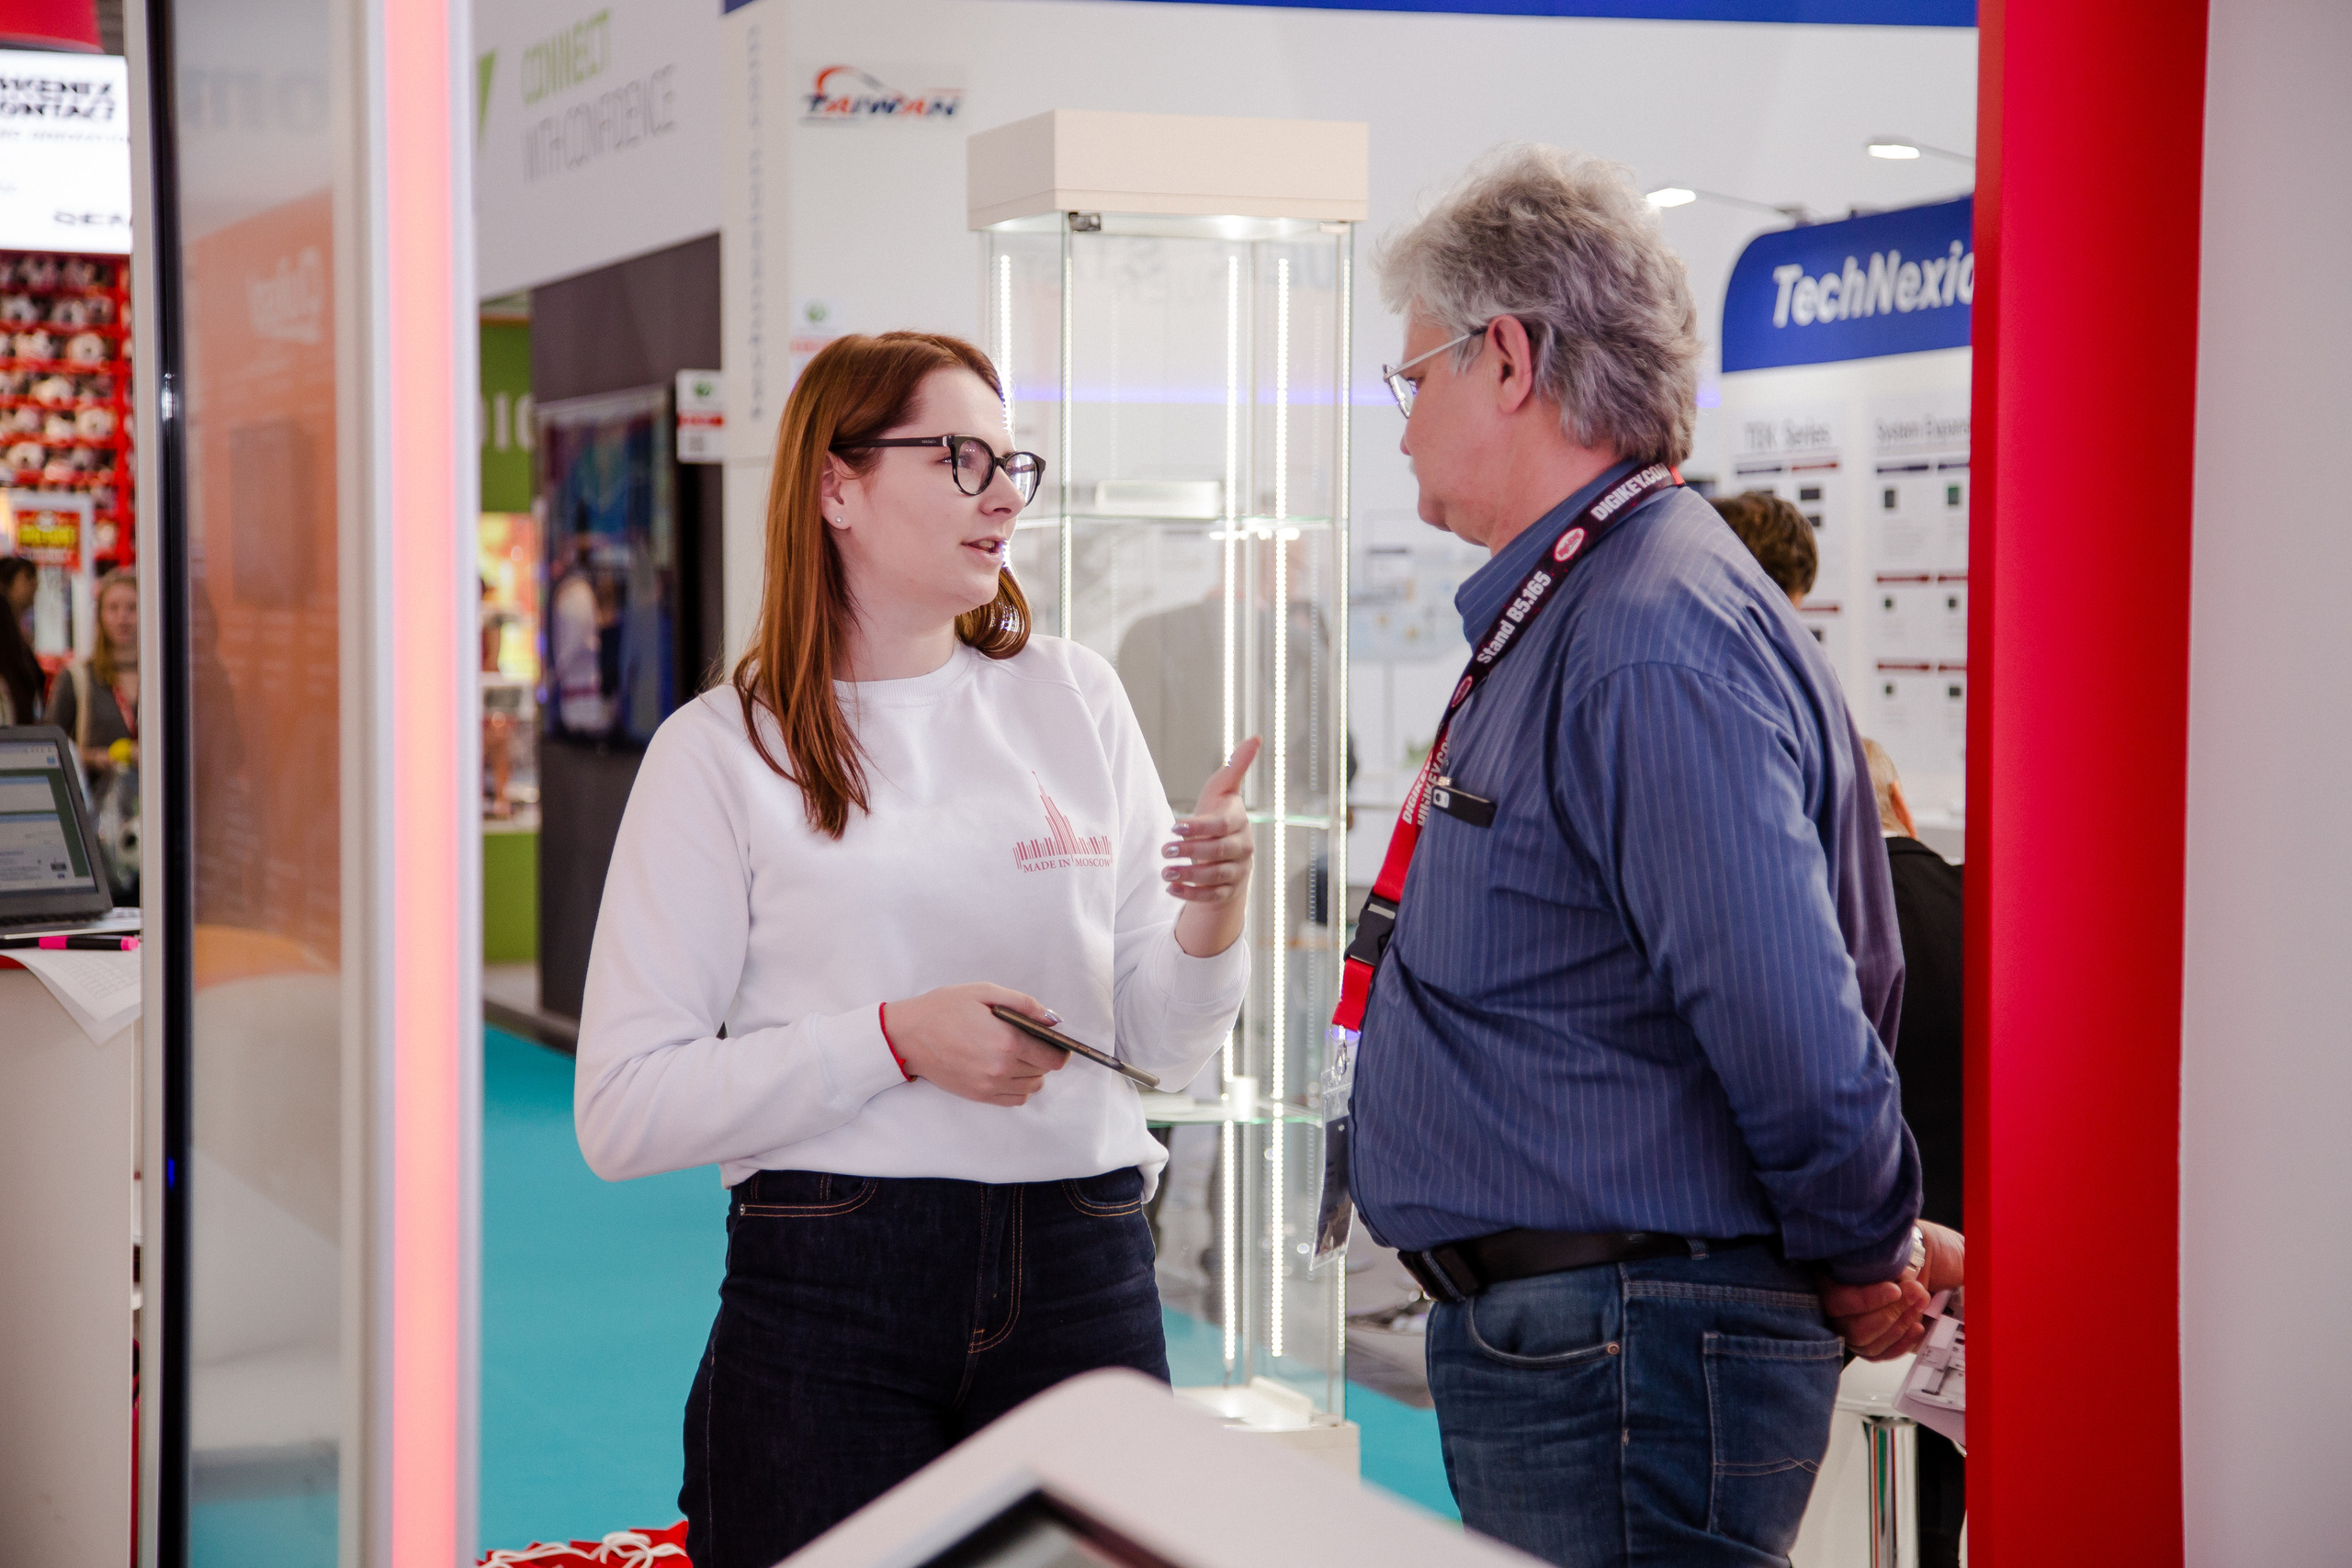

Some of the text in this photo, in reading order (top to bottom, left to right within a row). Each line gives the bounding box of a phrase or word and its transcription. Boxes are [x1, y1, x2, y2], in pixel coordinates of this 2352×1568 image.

[521, 8, 609, 107] CONNECT
[803, 95, 958, 117] TAIWAN
[1590, 463, 1670, 522] DIGIKEY.COM
[1476, 570, 1551, 663] Stand B5.165
[1023, 858, 1111, 873] MADE IN MOSCOW
